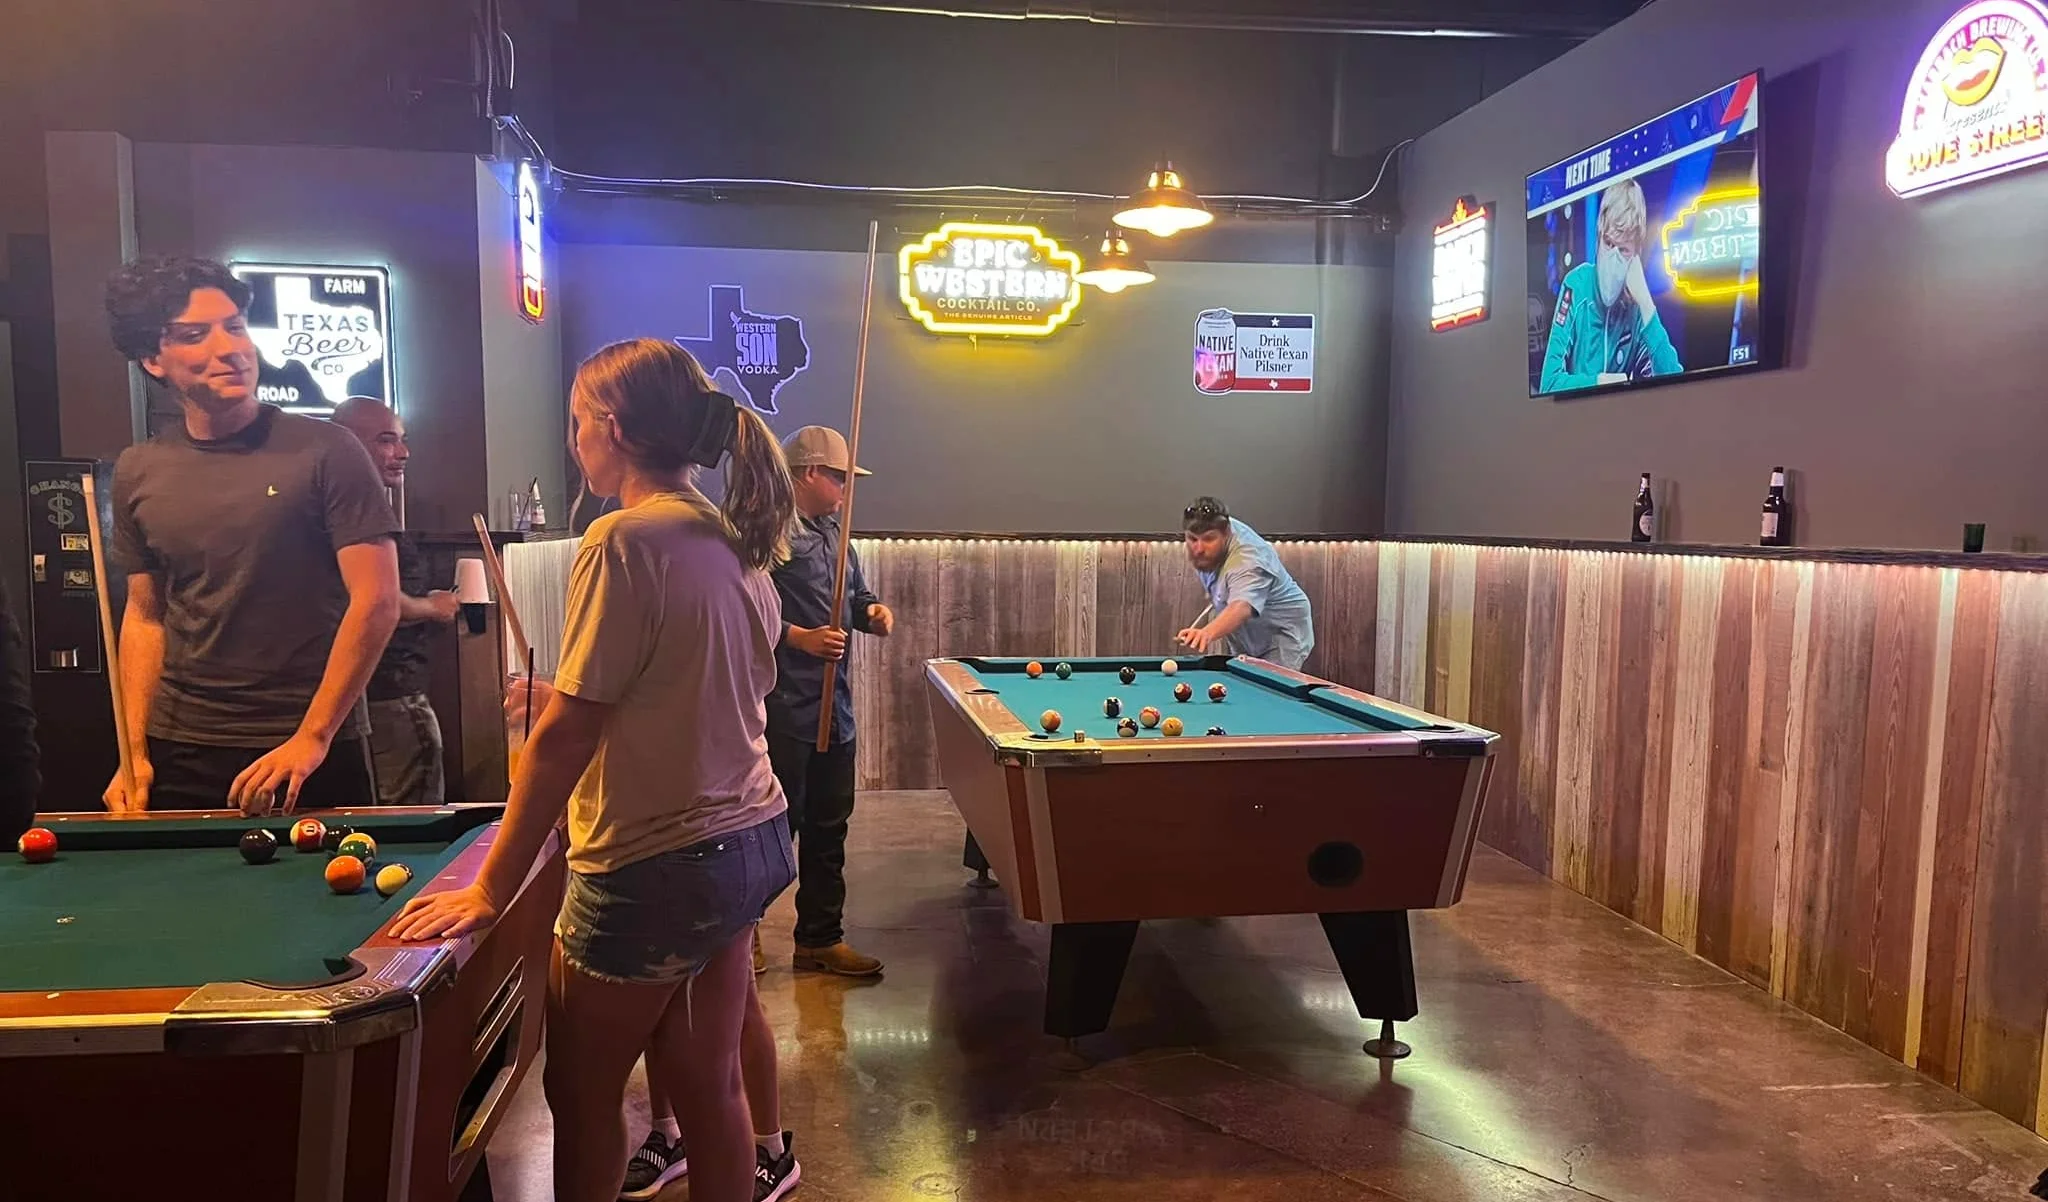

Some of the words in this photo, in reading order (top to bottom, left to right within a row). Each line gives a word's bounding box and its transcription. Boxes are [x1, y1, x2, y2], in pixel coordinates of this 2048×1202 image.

[1967, 110, 2048, 157] STREE
[1566, 158, 1589, 189] NEXT
[1590, 148, 1611, 179] TIME
[953, 238, 1029, 268] EPIC
[324, 278, 366, 294] FARM
[915, 264, 1067, 299] WESTERN
[937, 297, 1010, 311] COCKTAIL
[1016, 301, 1040, 312] CO.
[283, 314, 369, 332] TEXAS
[736, 323, 776, 333] WESTERN
[282, 333, 371, 356] Beer
[1199, 335, 1234, 351] NATIVE
[1260, 333, 1290, 347] Drink
[736, 332, 777, 366] SON
[1240, 346, 1274, 360] Native
[1276, 347, 1308, 361] Texan
[1732, 347, 1749, 361] FS1
[737, 365, 777, 374] VODKA
[1255, 360, 1293, 373] Pilsner
[257, 386, 299, 401] ROAD
[30, 480, 85, 495] CHANG
